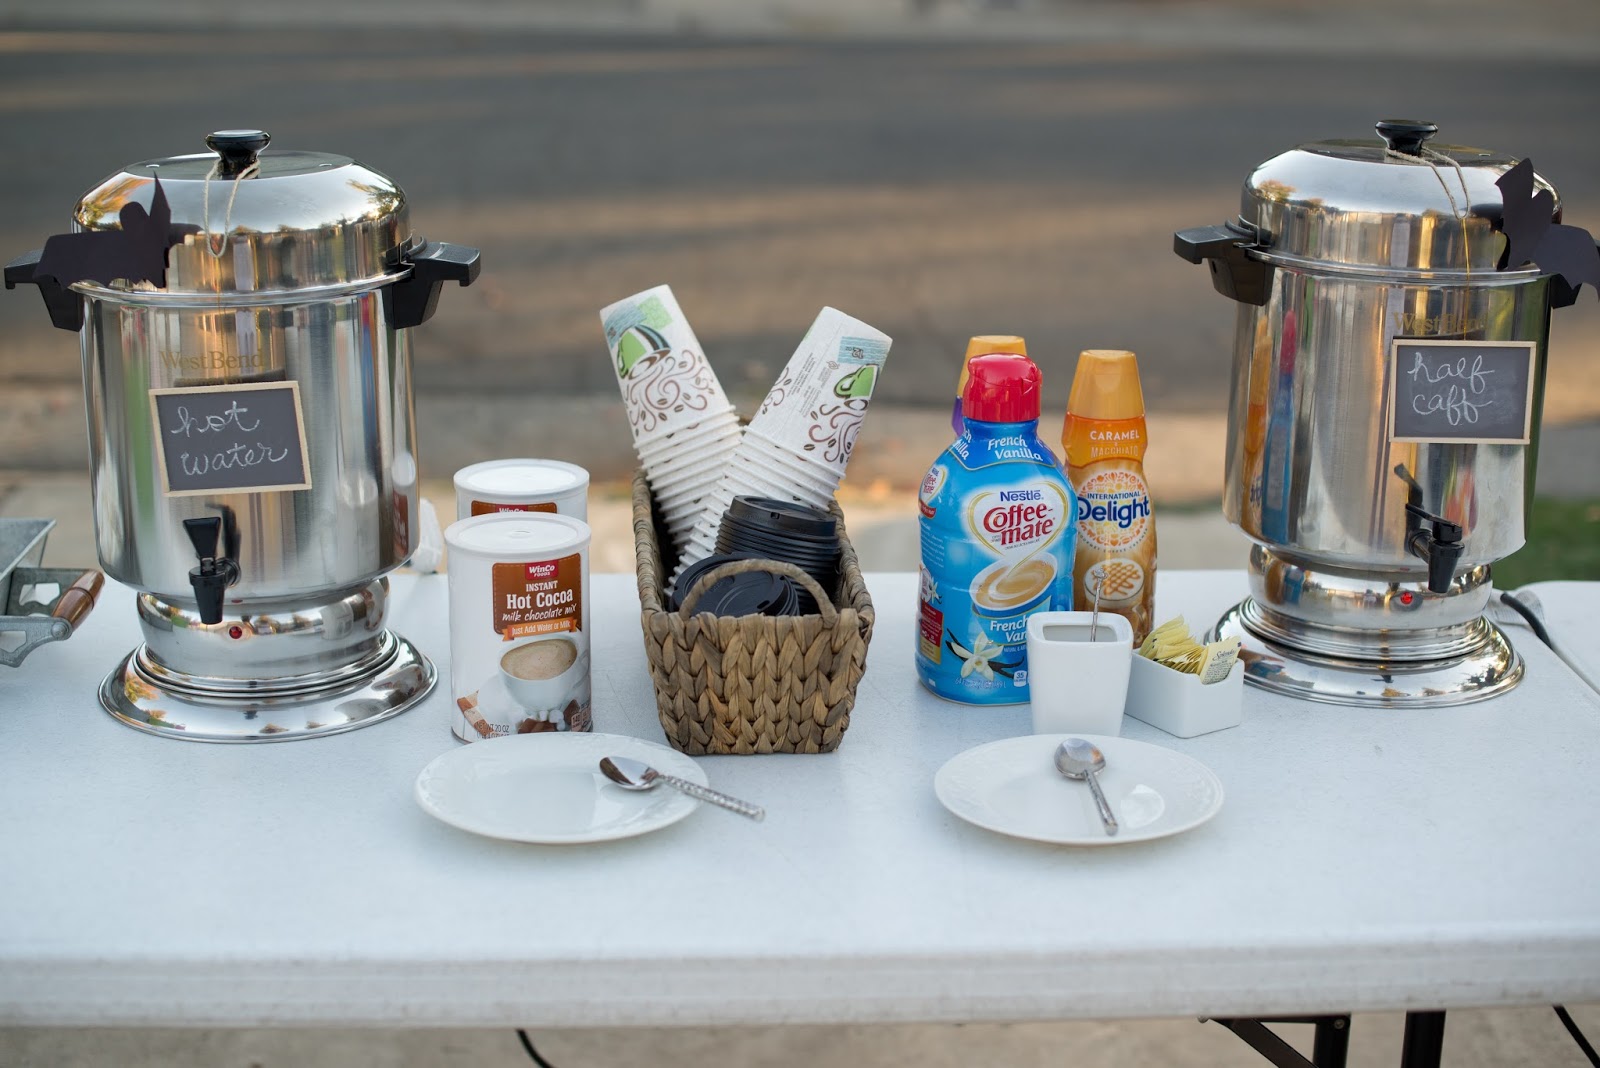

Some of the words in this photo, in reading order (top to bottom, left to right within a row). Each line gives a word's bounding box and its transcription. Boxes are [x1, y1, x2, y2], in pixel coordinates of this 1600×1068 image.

[1407, 352, 1495, 394] half
[1413, 384, 1494, 426] caff
[171, 401, 260, 437] hot
[987, 434, 1028, 451] French
[1090, 429, 1140, 440] CARAMEL
[181, 442, 288, 475] water
[995, 448, 1044, 462] Vanilla
[1090, 445, 1139, 458] MACCHIATO
[1087, 490, 1141, 500] INTERNATIONAL
[1077, 495, 1150, 529] Delight
[1000, 517, 1054, 546] mate
[528, 564, 556, 574] WinCo
[525, 580, 558, 592] INSTANT
[506, 593, 531, 609] Hot
[536, 588, 573, 608] Cocoa
[502, 610, 521, 622] milk
[524, 606, 563, 621] chocolate
[564, 603, 577, 615] mix
[511, 625, 524, 636] Just
[524, 623, 536, 634] Add
[537, 621, 553, 632] Water
[553, 621, 559, 630] or
[559, 619, 571, 630] Milk
[990, 615, 1029, 632] French
